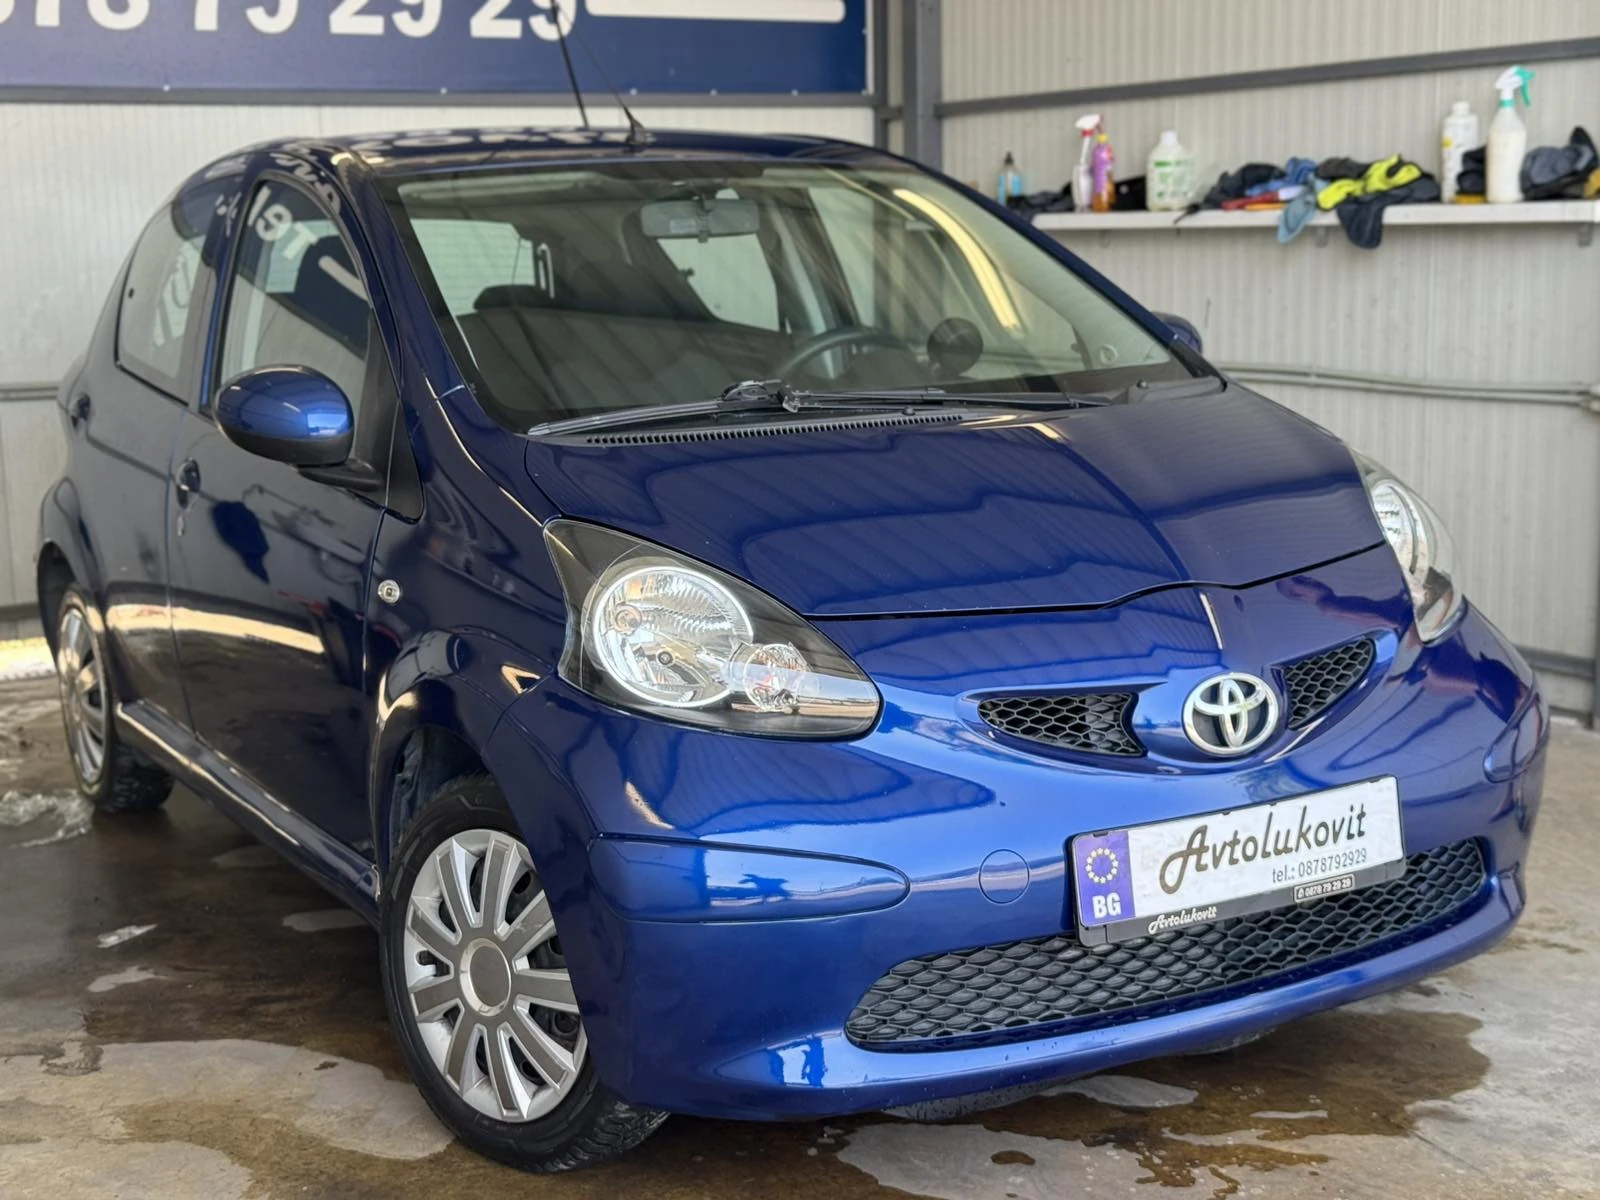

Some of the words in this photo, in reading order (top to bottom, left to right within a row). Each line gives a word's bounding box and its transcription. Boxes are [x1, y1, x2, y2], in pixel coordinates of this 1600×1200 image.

[1159, 803, 1367, 895] Avtolukovit
[1298, 847, 1367, 877] 0878792929
[1092, 892, 1122, 919] BG
[1148, 905, 1217, 934] Avtolukovit
